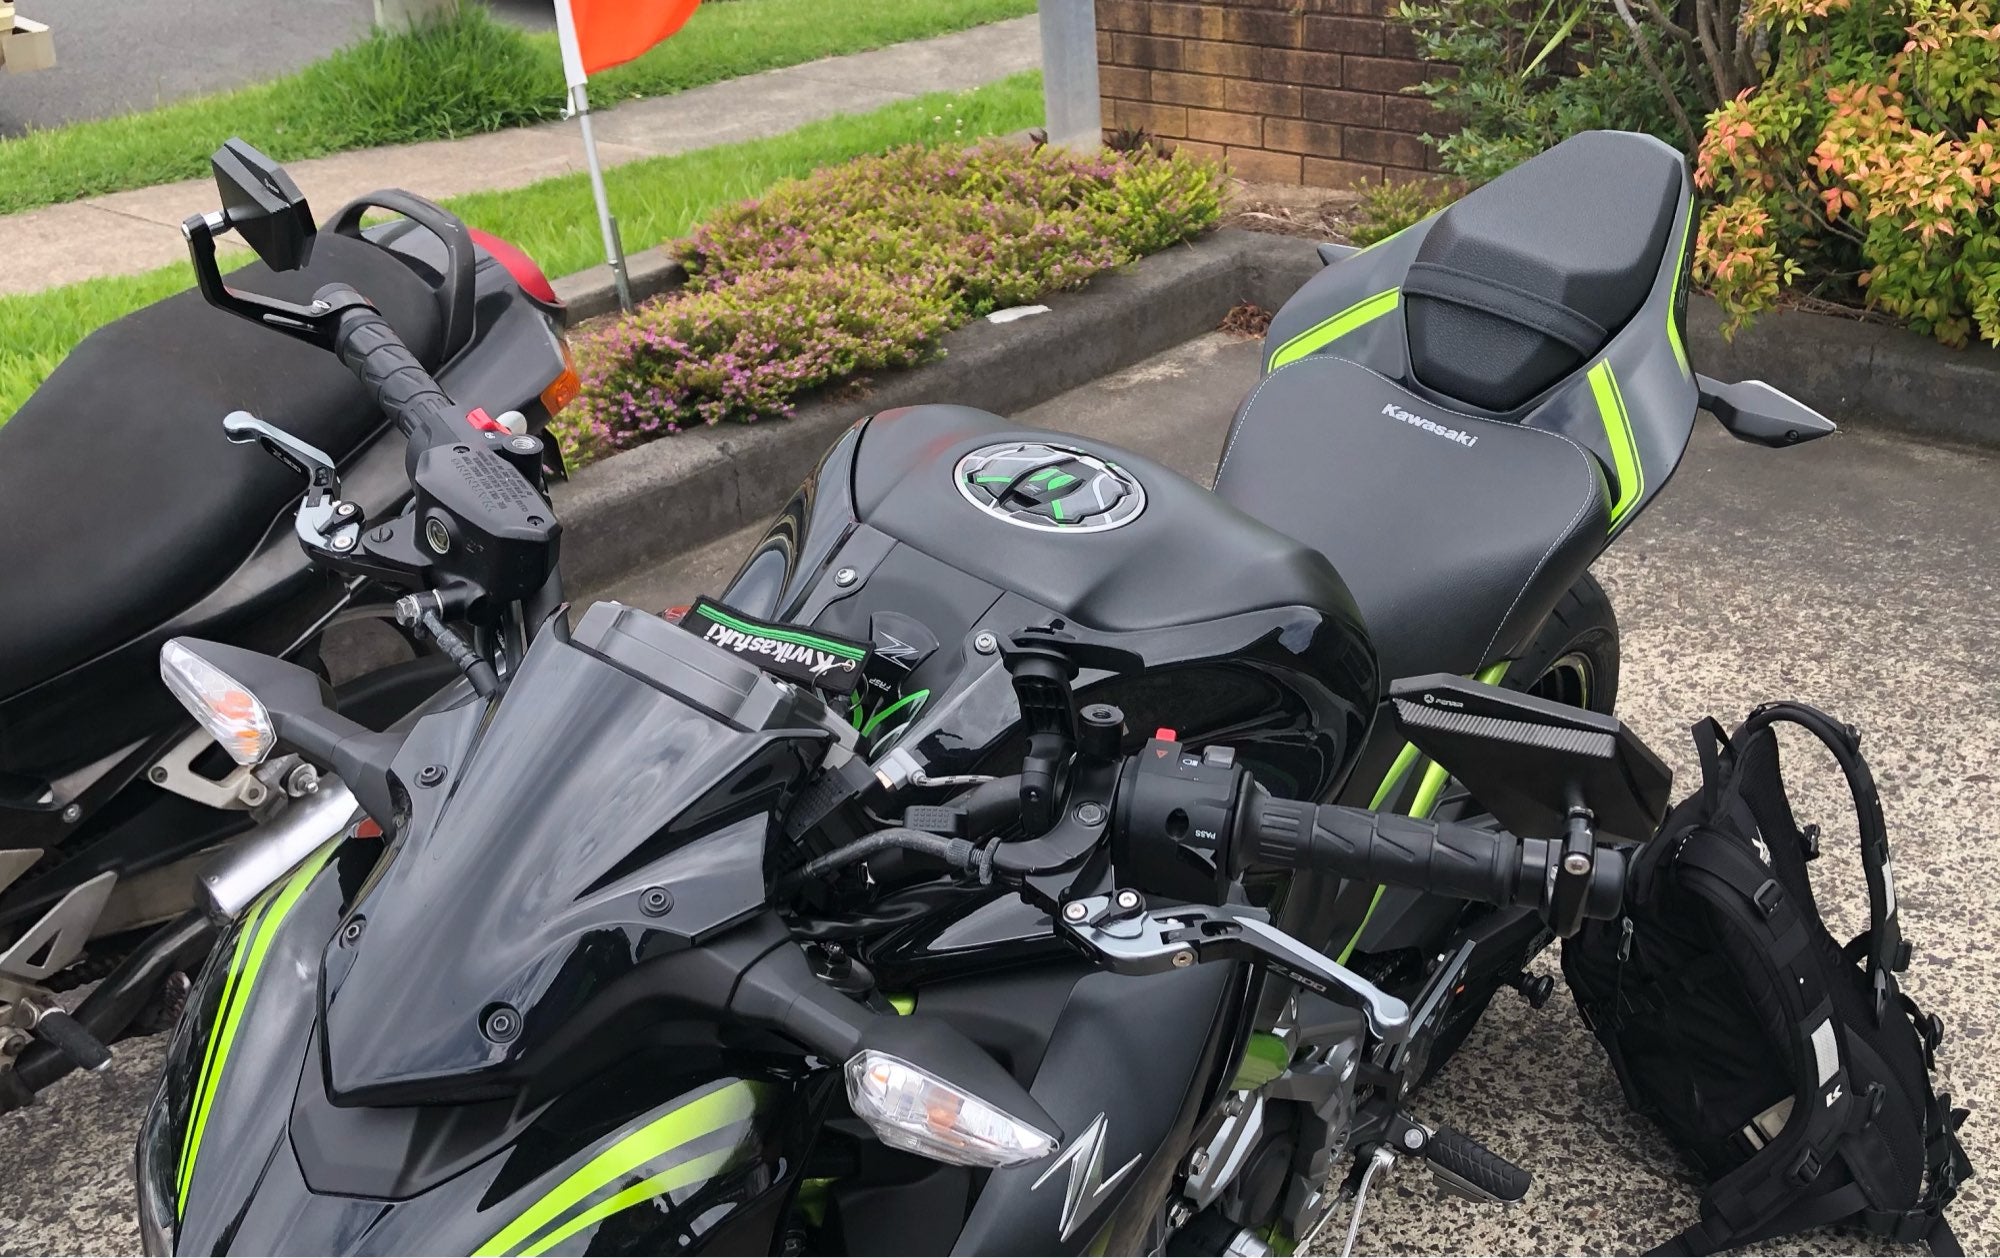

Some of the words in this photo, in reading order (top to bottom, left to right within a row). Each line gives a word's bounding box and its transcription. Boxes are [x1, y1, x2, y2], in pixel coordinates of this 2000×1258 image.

[1382, 403, 1479, 448] Kawasaki
[703, 622, 836, 676] Kwikasfuki
[1195, 829, 1216, 840] PASS
